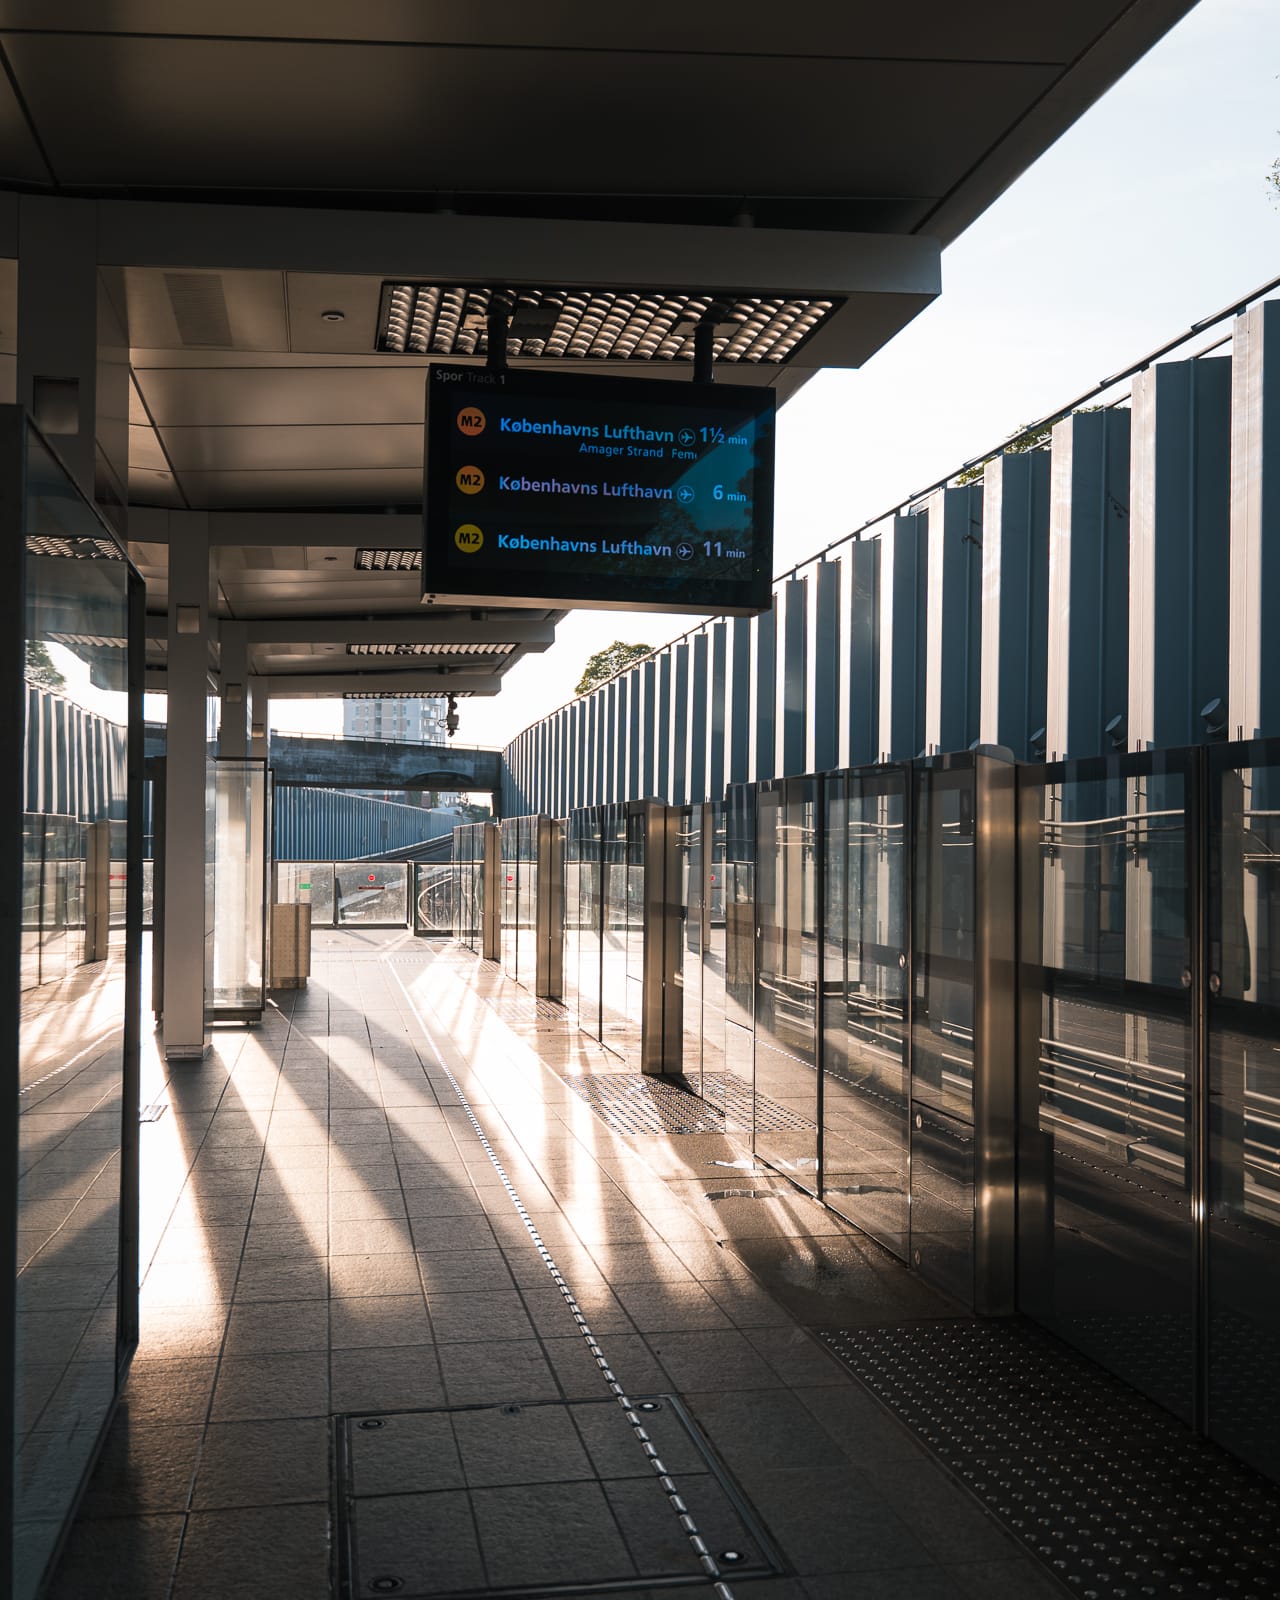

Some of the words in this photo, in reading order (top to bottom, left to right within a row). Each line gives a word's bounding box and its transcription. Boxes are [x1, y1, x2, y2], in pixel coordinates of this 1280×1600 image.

[435, 369, 463, 383] Spor
[467, 372, 496, 385] Track
[500, 374, 506, 385] 1
[461, 415, 482, 427] M2
[500, 418, 599, 438] Københavns
[604, 425, 674, 442] Lufthavn
[728, 434, 747, 445] min
[579, 443, 624, 457] Amager
[627, 446, 663, 458] Strand
[672, 449, 697, 460] Fem
[460, 474, 481, 486] M2
[499, 476, 598, 495] Københavns
[603, 482, 672, 500] Lufthavn
[713, 485, 723, 500] 6
[727, 492, 746, 502] min
[458, 532, 480, 544] M2
[498, 534, 597, 553] Københavns
[602, 540, 672, 557] Lufthavn
[703, 541, 722, 557] 11
[726, 549, 745, 559] min
